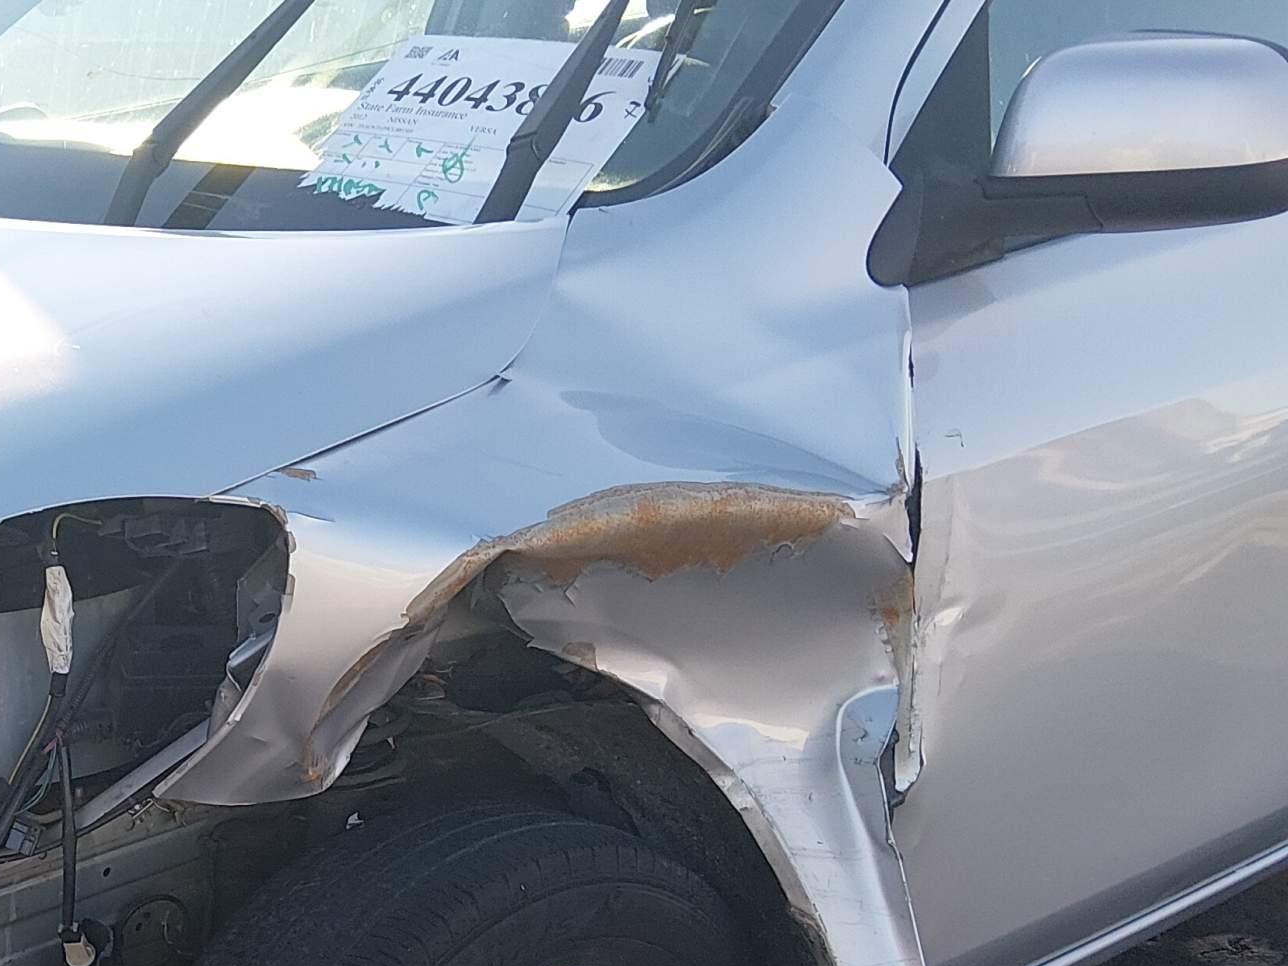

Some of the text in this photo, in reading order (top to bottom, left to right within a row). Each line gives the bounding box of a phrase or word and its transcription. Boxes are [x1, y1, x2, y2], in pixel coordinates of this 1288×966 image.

[387, 73, 617, 122] 4404386
[357, 103, 469, 121] State Farm Insurance
[470, 125, 498, 136] VERSA
